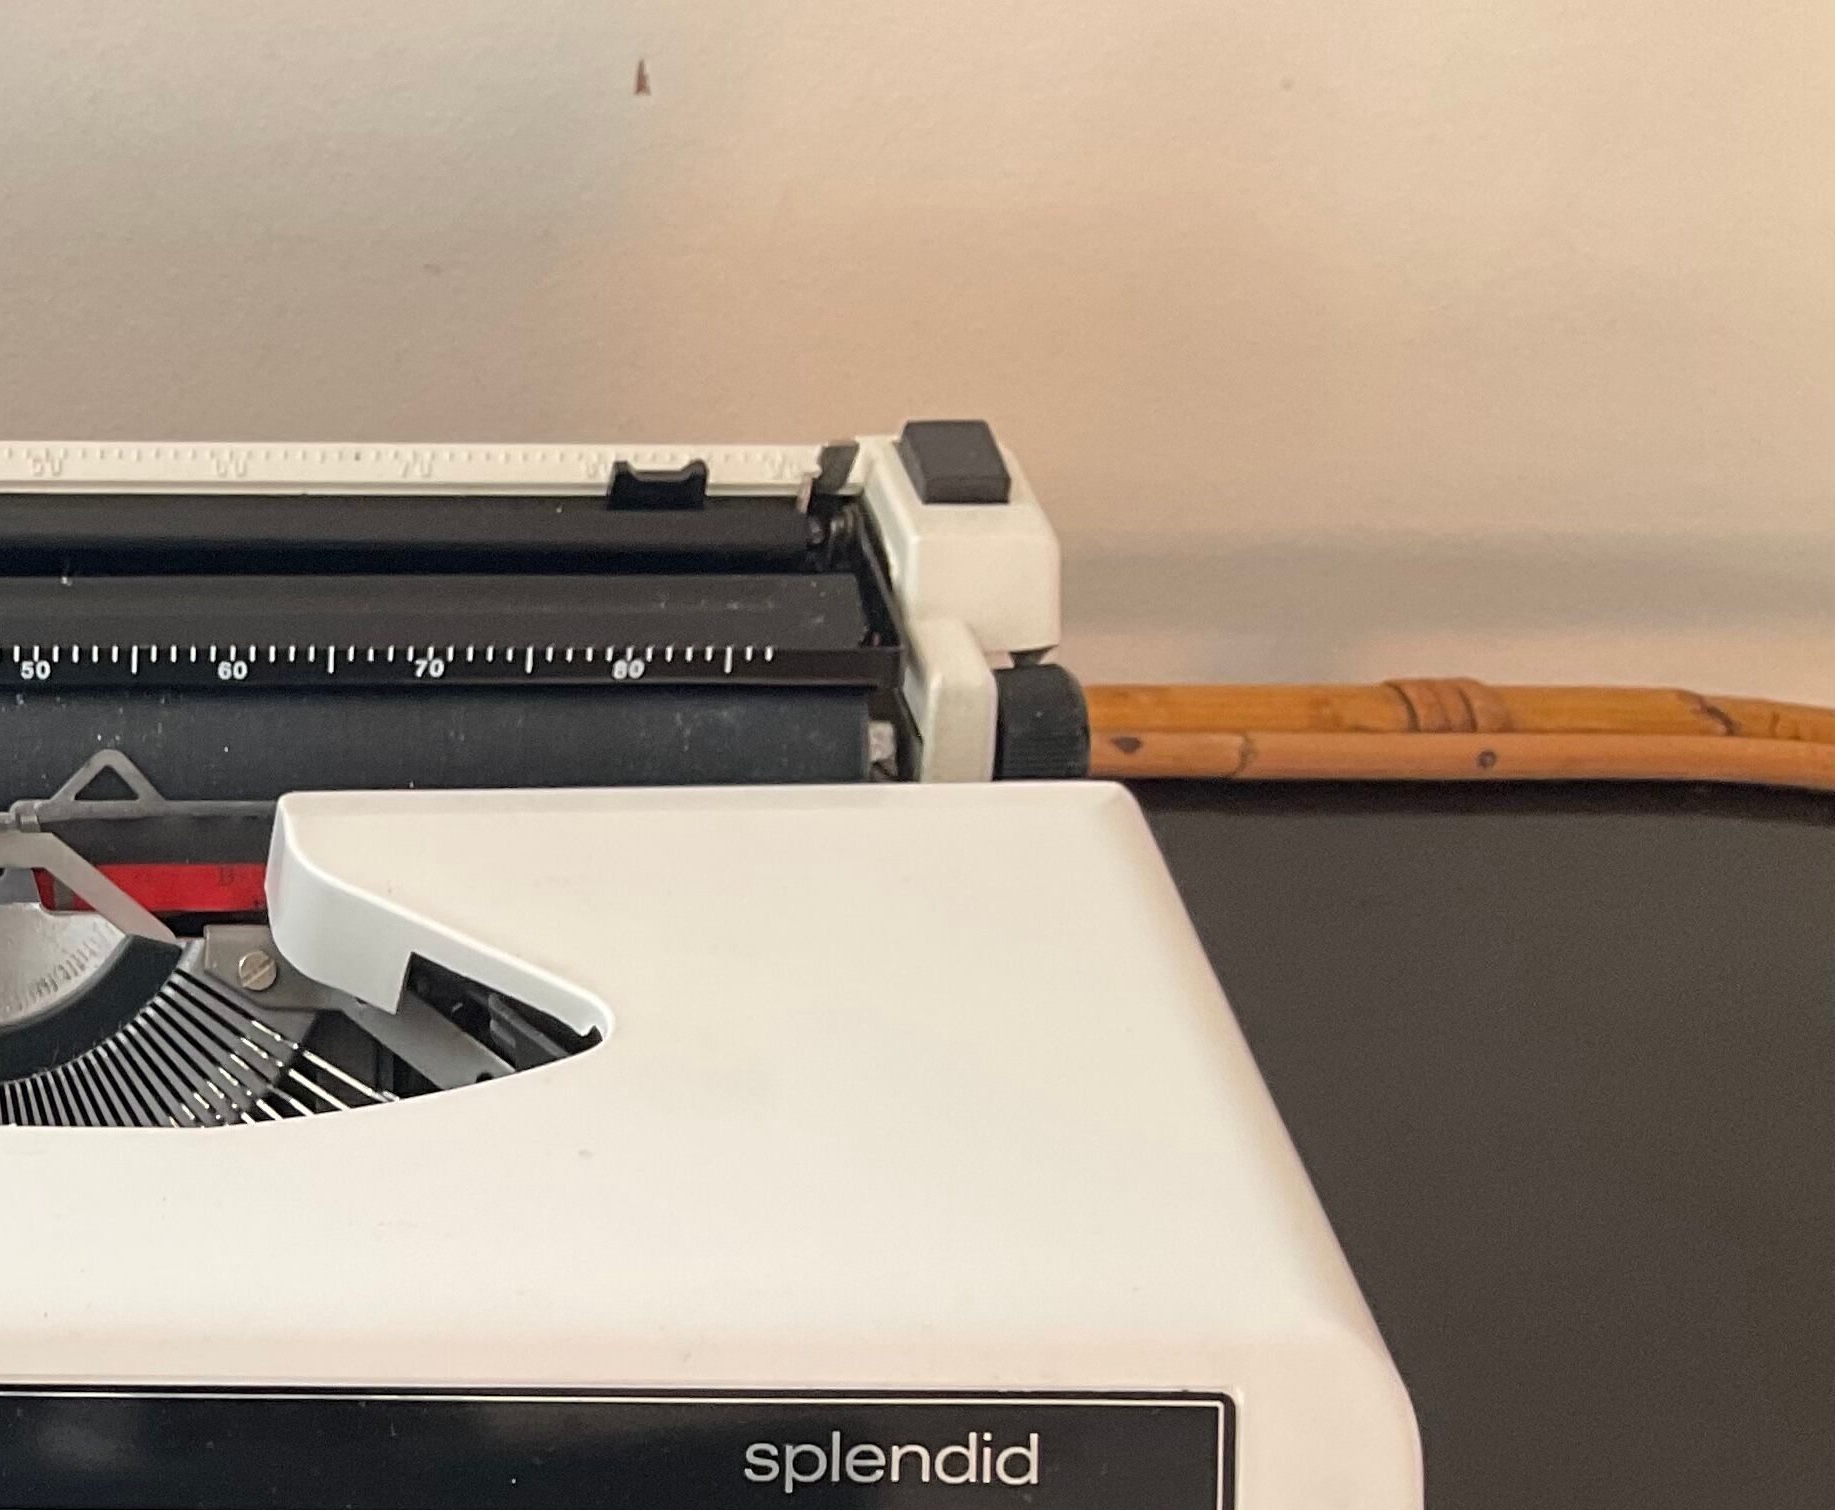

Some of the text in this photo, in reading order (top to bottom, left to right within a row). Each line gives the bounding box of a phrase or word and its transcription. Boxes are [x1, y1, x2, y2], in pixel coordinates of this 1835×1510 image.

[20, 659, 51, 680] 50
[217, 660, 248, 680] 60
[415, 658, 445, 678] 70
[613, 659, 645, 680] 80
[744, 1430, 1039, 1494] splendid
